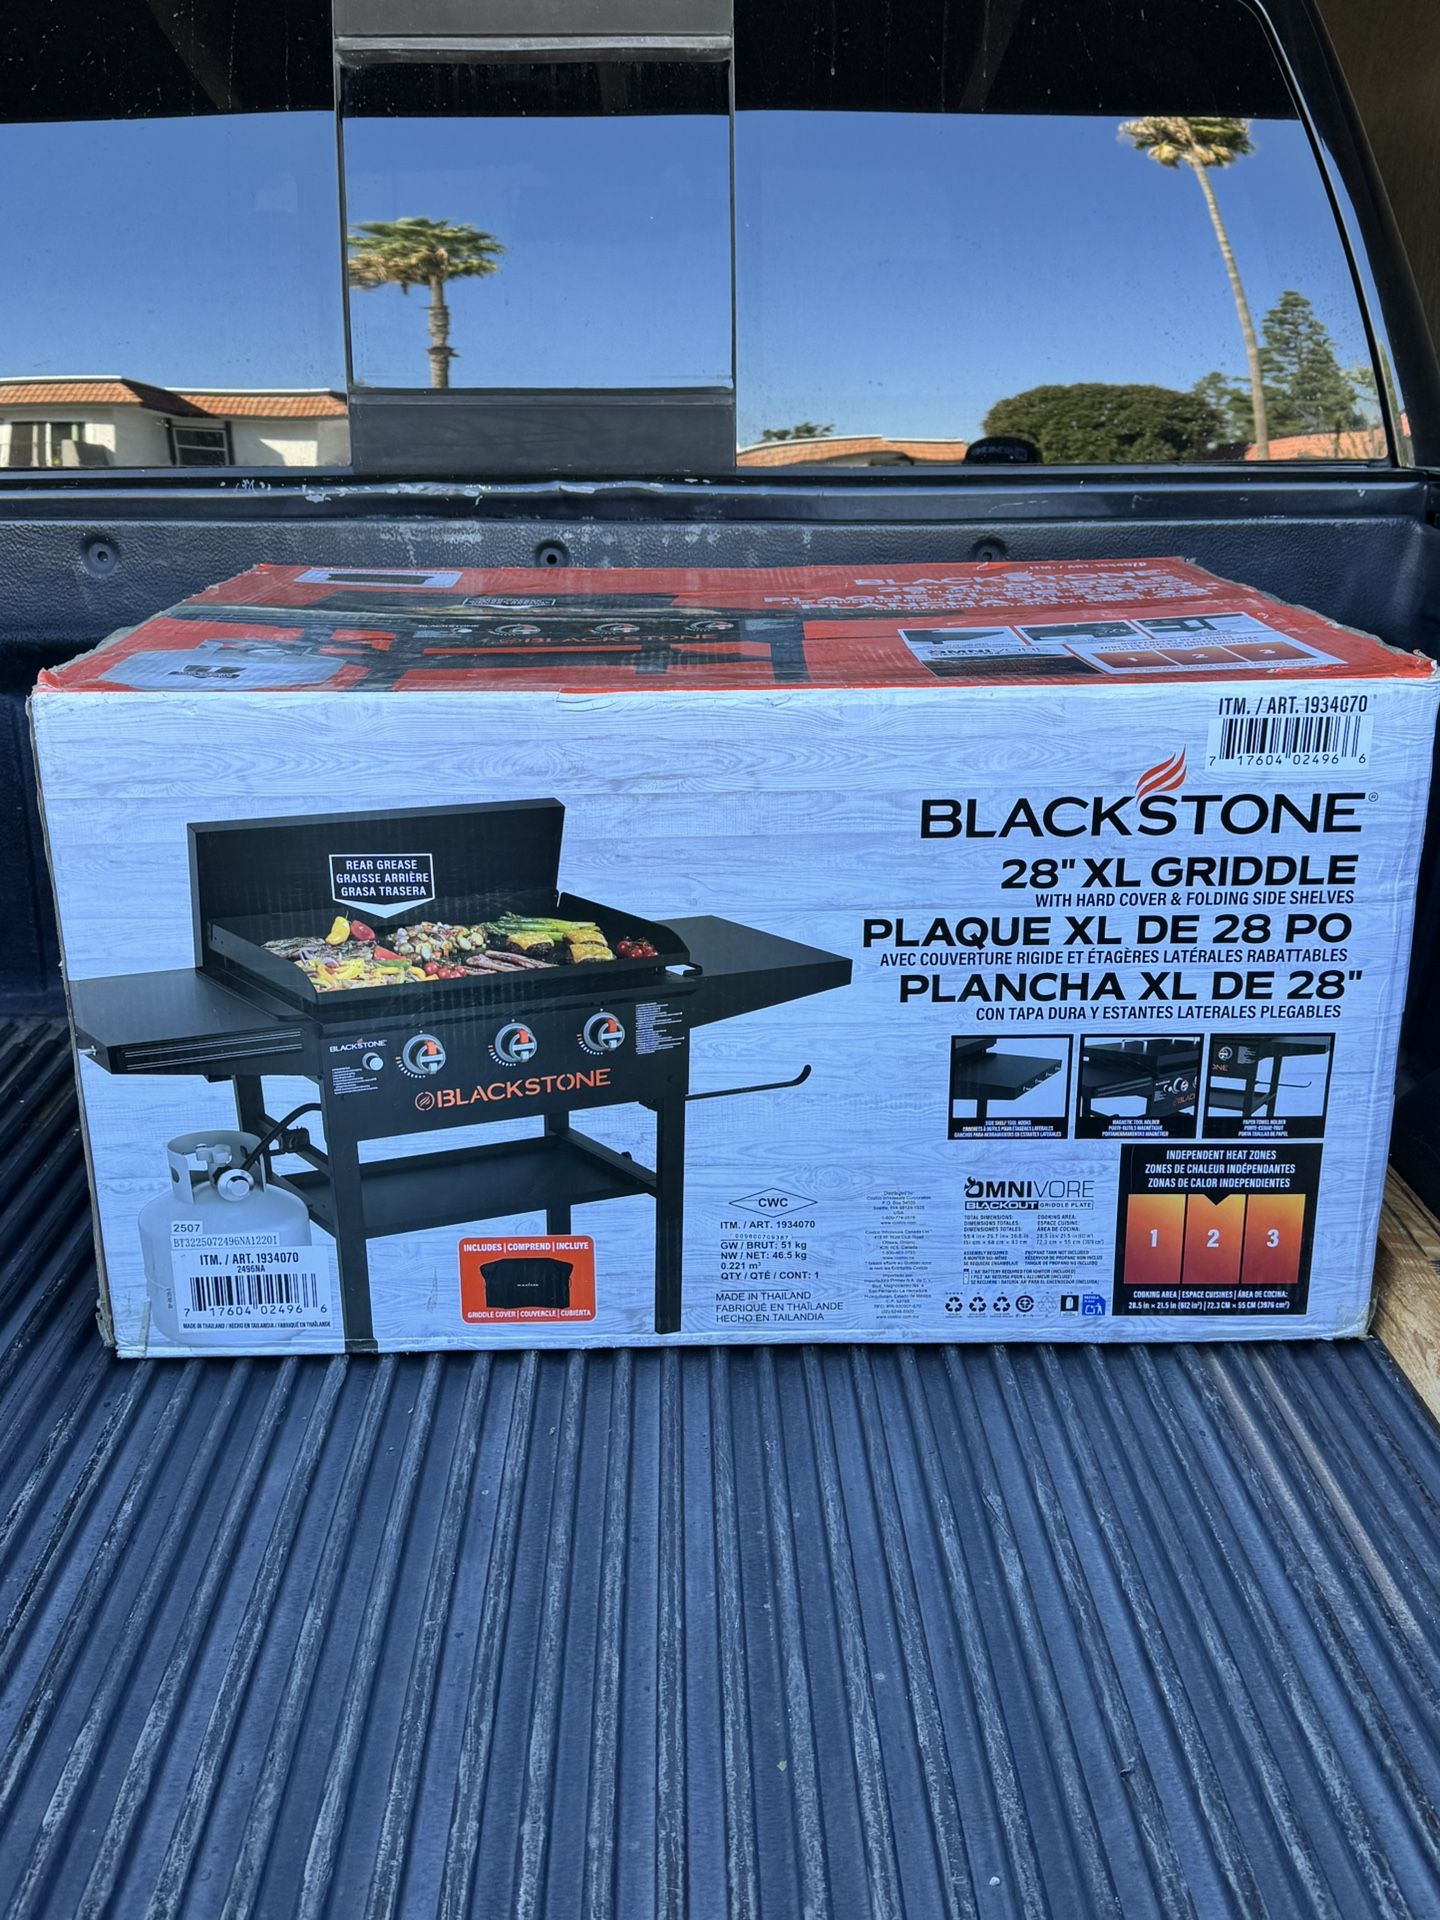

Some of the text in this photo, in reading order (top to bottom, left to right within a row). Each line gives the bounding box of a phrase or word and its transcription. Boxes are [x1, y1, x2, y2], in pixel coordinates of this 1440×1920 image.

[525, 634, 718, 643] BLACKSTONE
[1219, 698, 1250, 715] ITM.
[1267, 696, 1298, 714] ART.
[1305, 695, 1367, 713] 1934070
[1209, 753, 1366, 766] 7 17604 02496 6
[346, 860, 417, 870] REAR GREASE
[336, 871, 429, 883] GRAISSE ARRIÈRE
[1001, 855, 1359, 889] 28" XL GRIDDLE
[341, 886, 426, 896] GRASA TRASERA
[1036, 890, 1354, 907] WITH HARD COVER & FOLDING SIDE SHELVES
[864, 913, 1352, 950] PLAQUE XL DE 28 PO
[880, 947, 1347, 966] AVEC COUVERTURE RIGIDE ET ÉTAGÈRES LATÉRALES RABATTABLES
[900, 970, 1362, 1003] PLANCHA XL DE 28"
[976, 1005, 1341, 1020] CON TAPA DURA Y ESTANTES LATERALES PLEGABLES
[330, 1040, 386, 1052] BLACKSTONE
[438, 1068, 611, 1107] BLACKSTONE
[1167, 1150, 1276, 1160] INDEPENDENT HEAT ZONES
[1145, 1163, 1295, 1173] ZONES DE CHALEUR INDÉPENDANTES
[964, 1177, 1095, 1198] OMNIVORE
[1148, 1178, 1290, 1187] ZONAS DE CALOR INDEPENDIENTES
[759, 1198, 788, 1207] CWC
[966, 1202, 1037, 1210] BLACKOUT
[174, 1224, 200, 1232] 2507
[776, 1220, 815, 1228] 1934070
[1150, 1229, 1279, 1247] 1 2 3
[508, 1243, 551, 1251] COMPREND
[556, 1242, 588, 1250] INCLUYE
[747, 1241, 777, 1249] BRUT:
[795, 1241, 806, 1250] kg
[200, 1255, 222, 1265] ITM.
[233, 1253, 254, 1265] ART.
[256, 1252, 298, 1263] 1934070
[746, 1251, 769, 1259] NET:
[772, 1251, 792, 1259] 46.5
[795, 1251, 807, 1260] kg
[721, 1262, 745, 1270] 0.221
[721, 1272, 741, 1280] QTY
[750, 1270, 770, 1280] QTÉ
[779, 1271, 811, 1279] CONT:
[716, 1293, 745, 1301] MADE
[761, 1291, 811, 1300] THAILAND
[184, 1304, 327, 1317] 7 17604 02496 6
[716, 1302, 843, 1312] FABRIQUÉ EN THAÏLANDE
[716, 1313, 824, 1324] HECHO EN TAILANDIA
